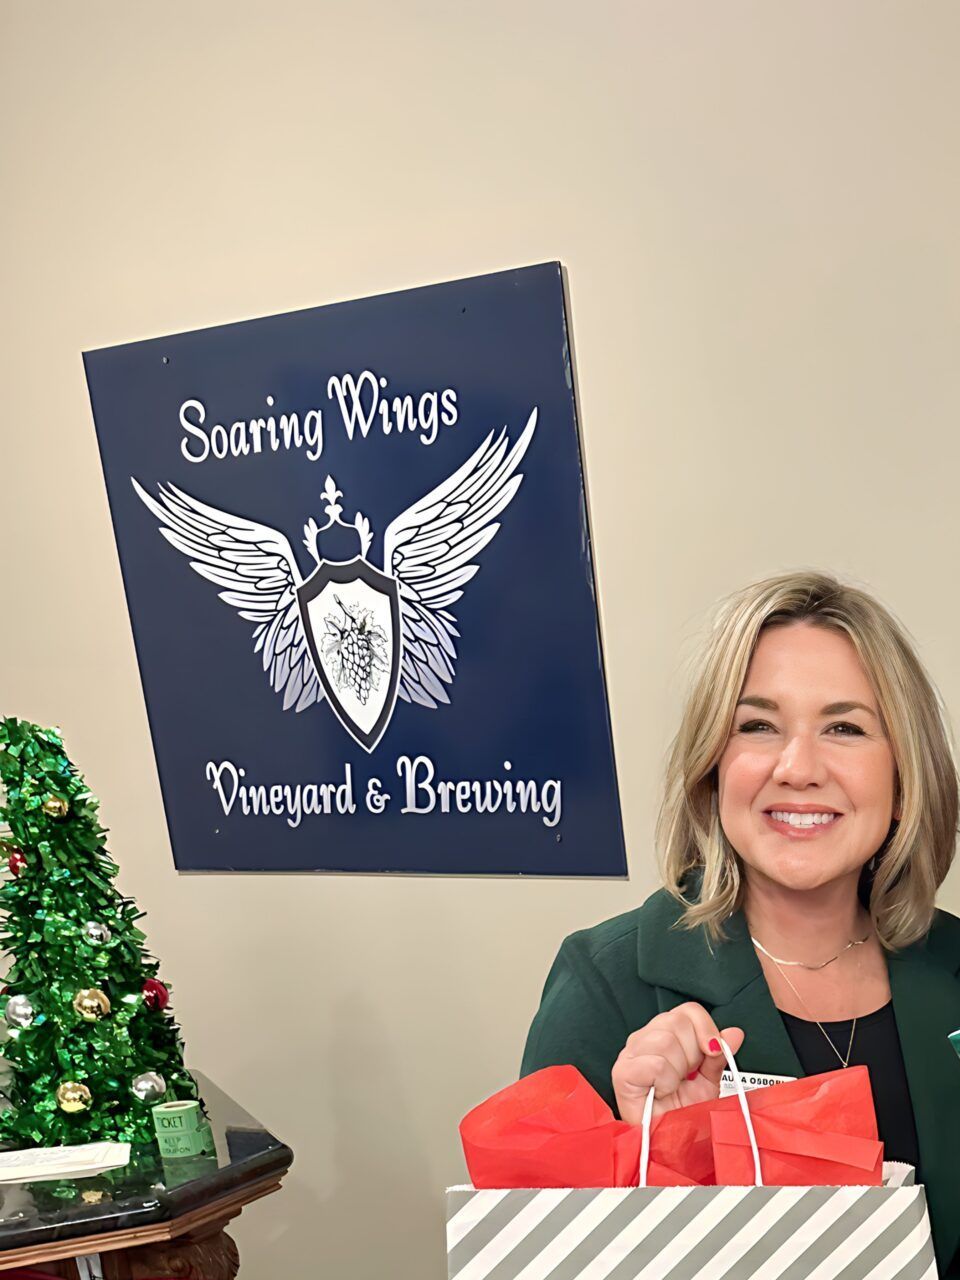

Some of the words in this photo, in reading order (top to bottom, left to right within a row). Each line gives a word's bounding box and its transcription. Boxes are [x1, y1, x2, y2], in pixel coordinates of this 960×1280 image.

[179, 396, 324, 464] Soaring
[327, 370, 460, 446] Wings
[205, 760, 357, 829] Vineyard
[365, 778, 391, 815] &
[396, 755, 563, 828] Brewing
[722, 1074, 747, 1083] AUA
